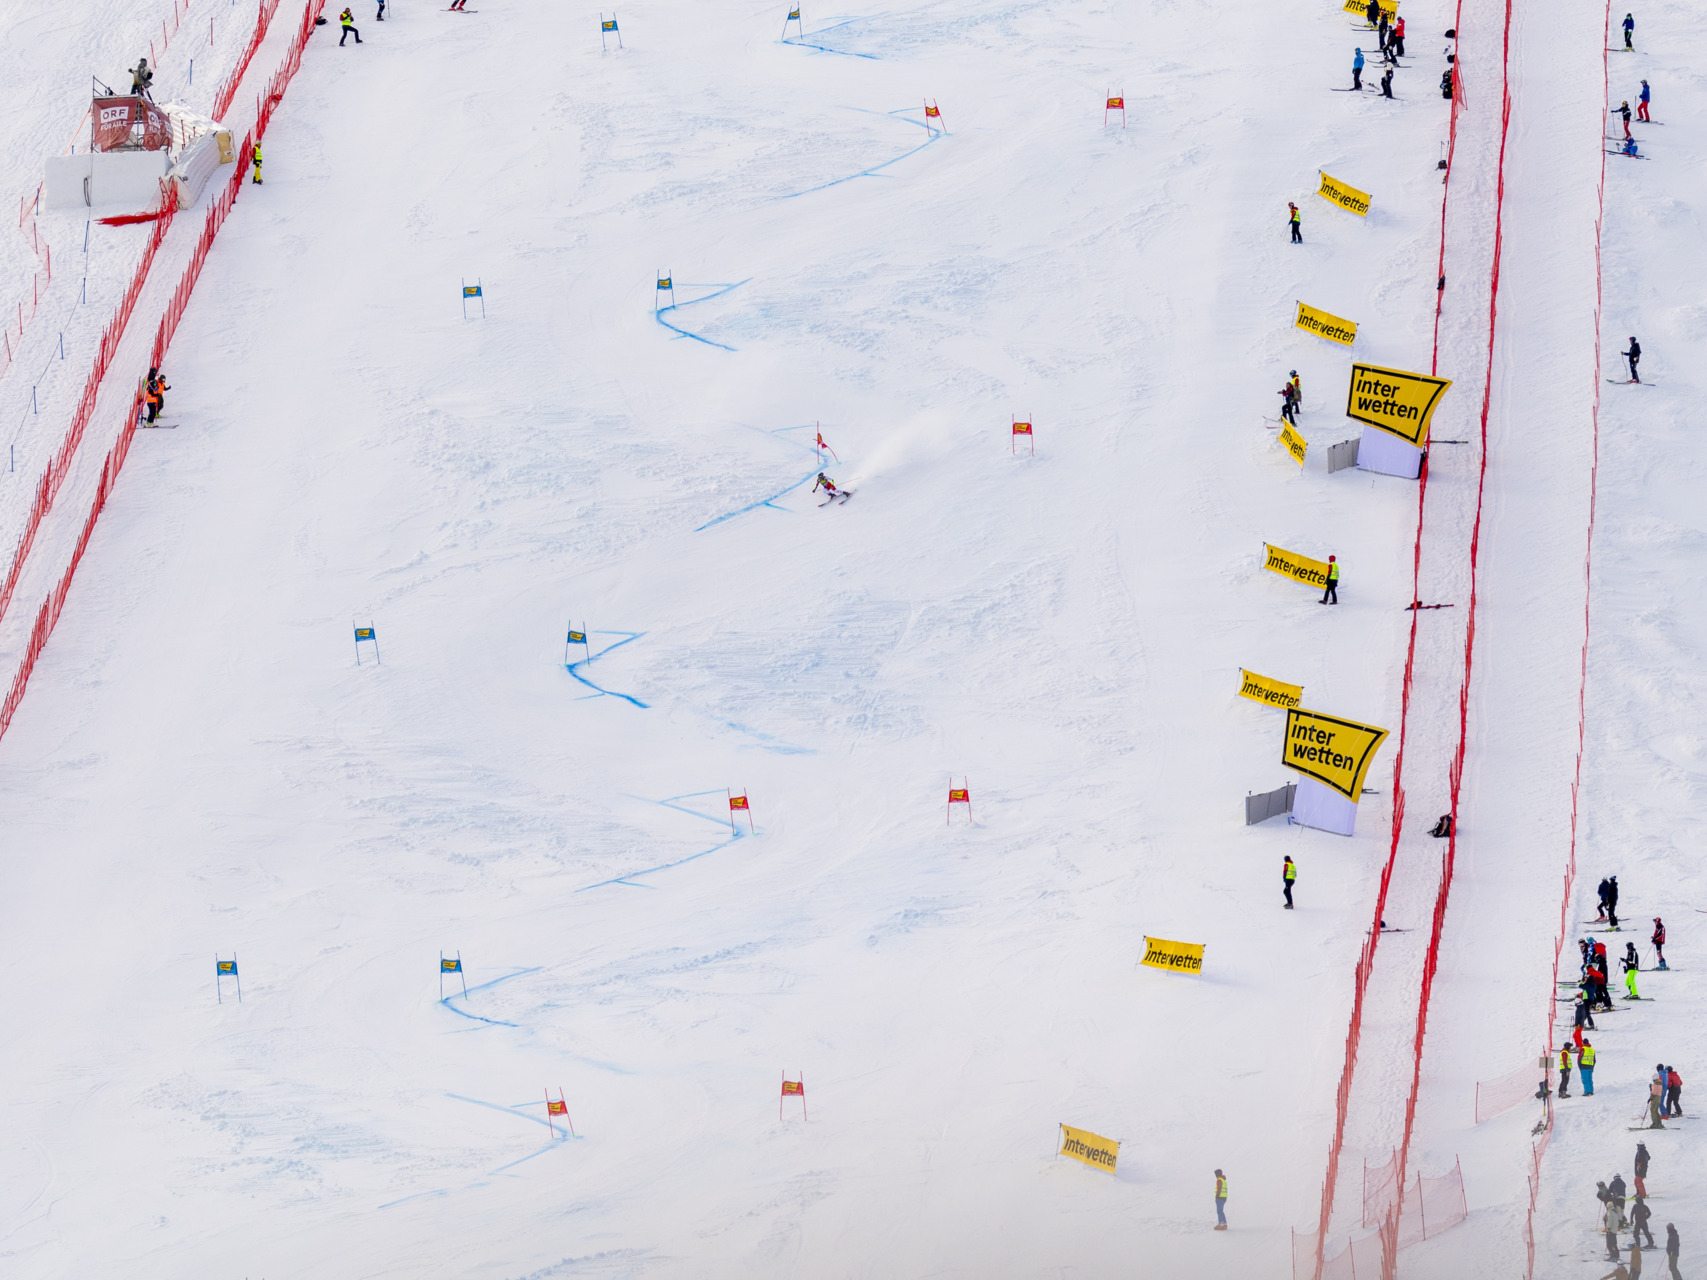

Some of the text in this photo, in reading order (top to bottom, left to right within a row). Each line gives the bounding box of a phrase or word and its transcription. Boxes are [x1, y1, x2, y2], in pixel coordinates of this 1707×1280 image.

[102, 108, 126, 120] ORF
[1356, 370, 1400, 398] inter
[1358, 397, 1419, 420] wetten
[1291, 714, 1336, 746] inter
[1293, 743, 1354, 771] wetten
